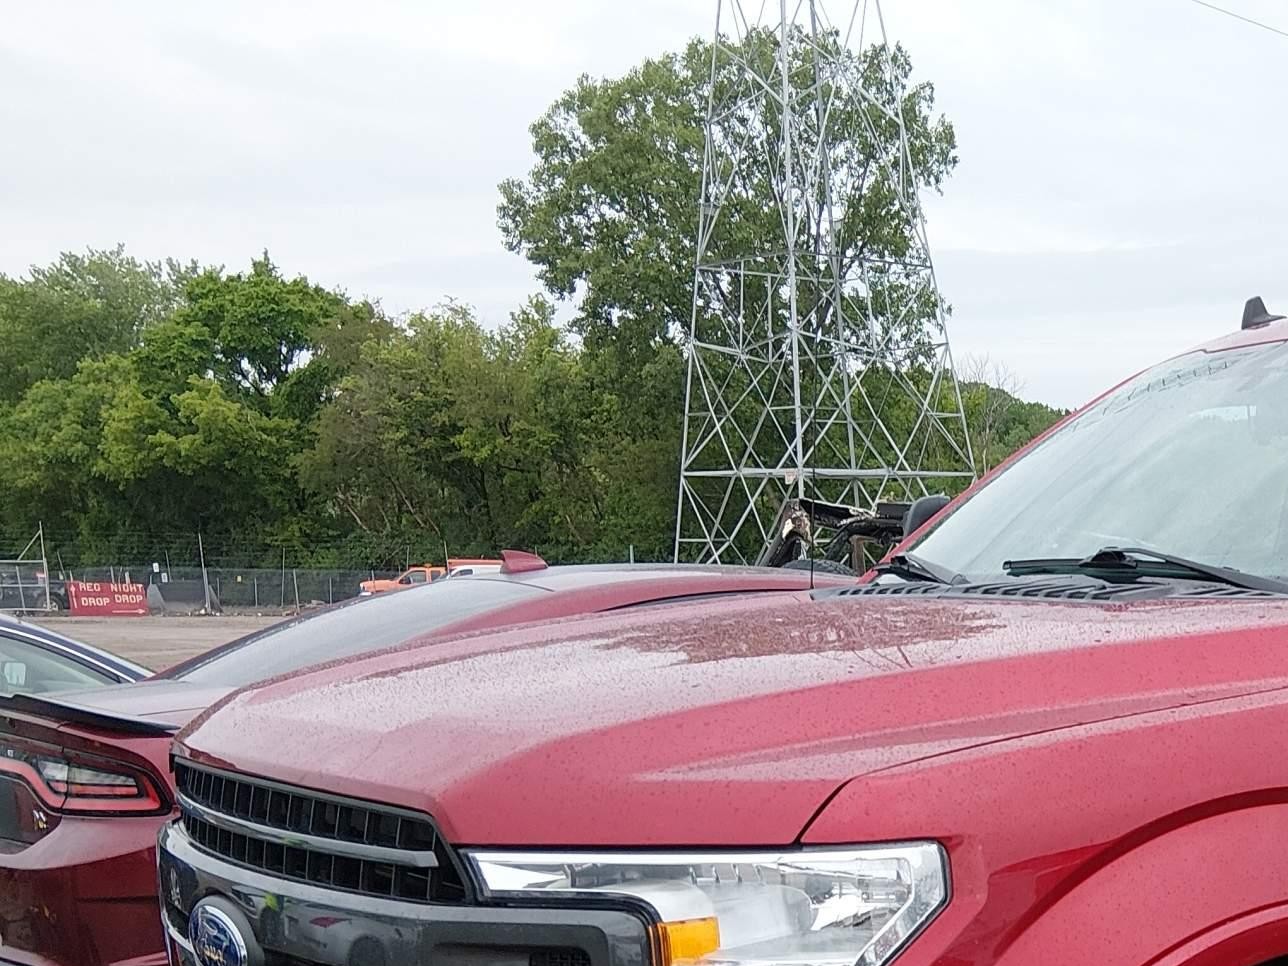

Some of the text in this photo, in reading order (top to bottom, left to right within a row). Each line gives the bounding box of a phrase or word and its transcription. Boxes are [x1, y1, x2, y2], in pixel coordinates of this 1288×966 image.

[110, 583, 144, 593] NIGHT
[81, 597, 110, 607] DROP
[114, 594, 143, 604] DROP
